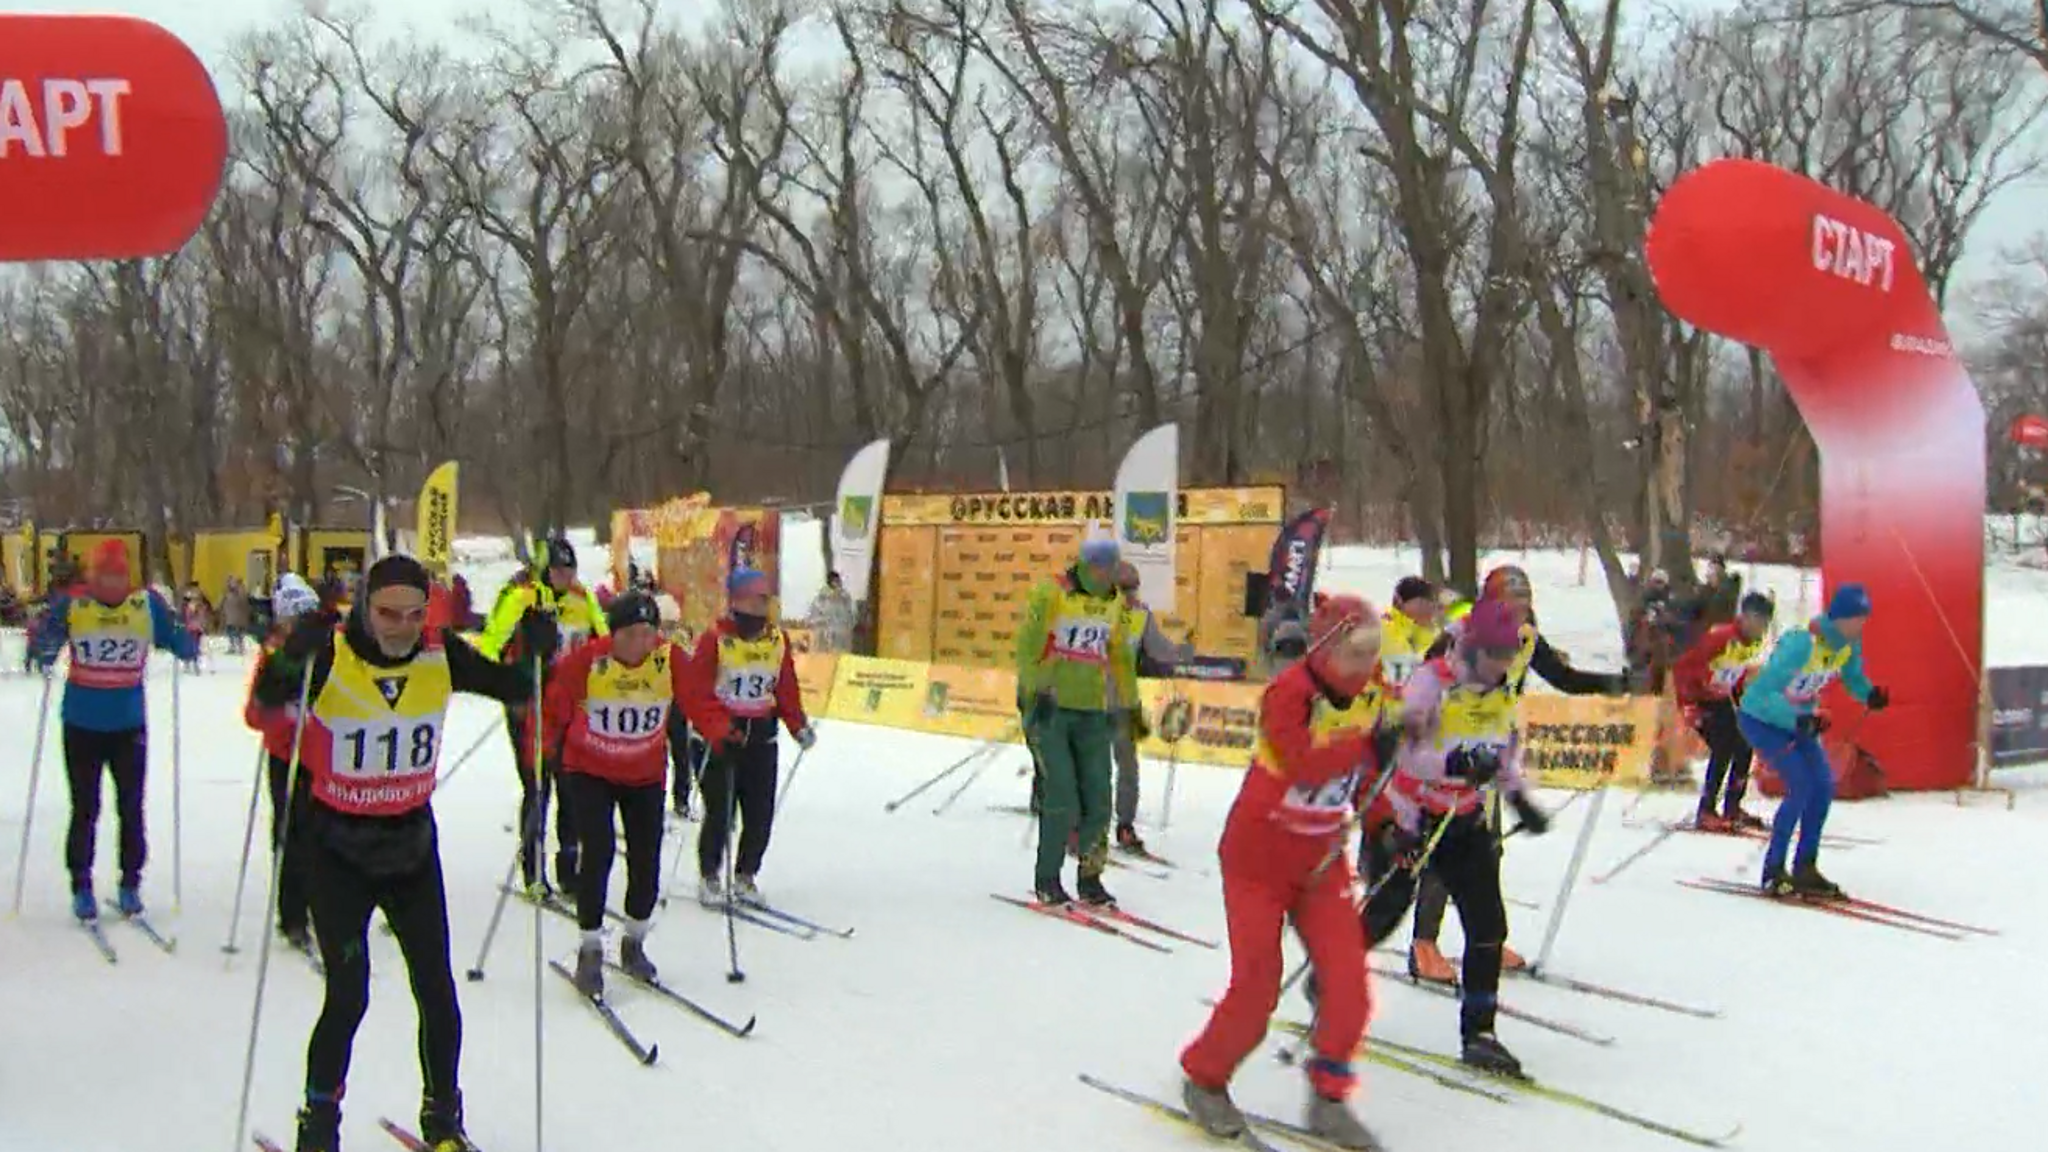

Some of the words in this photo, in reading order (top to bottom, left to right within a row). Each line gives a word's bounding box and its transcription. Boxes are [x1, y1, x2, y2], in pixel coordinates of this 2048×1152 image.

[0, 78, 132, 158] АРТ
[1812, 213, 1895, 293] СТАРТ
[79, 638, 136, 661] 122
[594, 705, 661, 733] 108
[344, 723, 434, 771] 118
